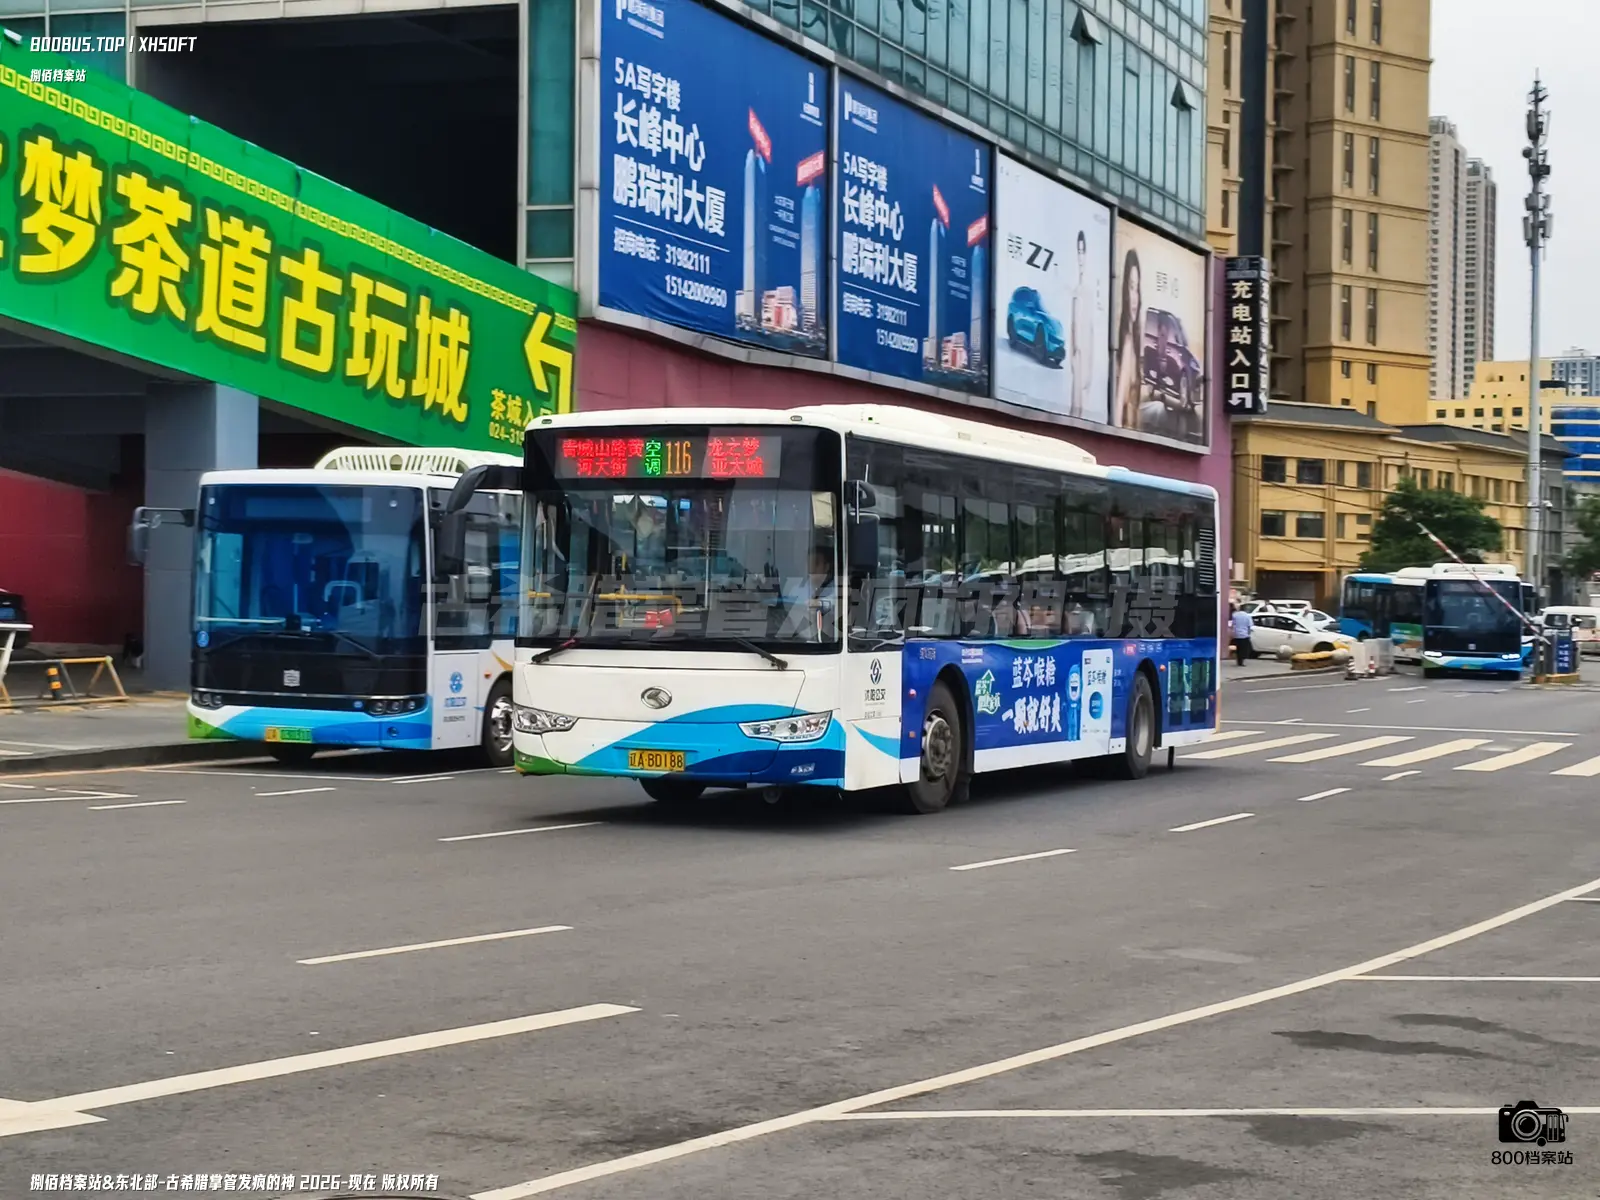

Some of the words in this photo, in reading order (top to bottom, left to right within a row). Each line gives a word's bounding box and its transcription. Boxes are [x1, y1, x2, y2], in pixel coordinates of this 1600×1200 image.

[614, 56, 682, 112] 5A写字楼
[613, 92, 706, 172] 长峰中心
[612, 153, 727, 237] 鹏瑞利大厦
[843, 151, 888, 193] 5A写字楼
[842, 180, 905, 242] 长峰中心
[0, 136, 471, 423] 梦茶道古玩城
[841, 231, 918, 295] 鹏瑞利大厦
[1026, 241, 1055, 272] Z7
[1230, 280, 1253, 389] 充电站入口
[644, 439, 662, 476] 空调
[664, 440, 692, 475] 116
[707, 436, 761, 458] 龙之梦
[710, 456, 765, 477] 亚太城
